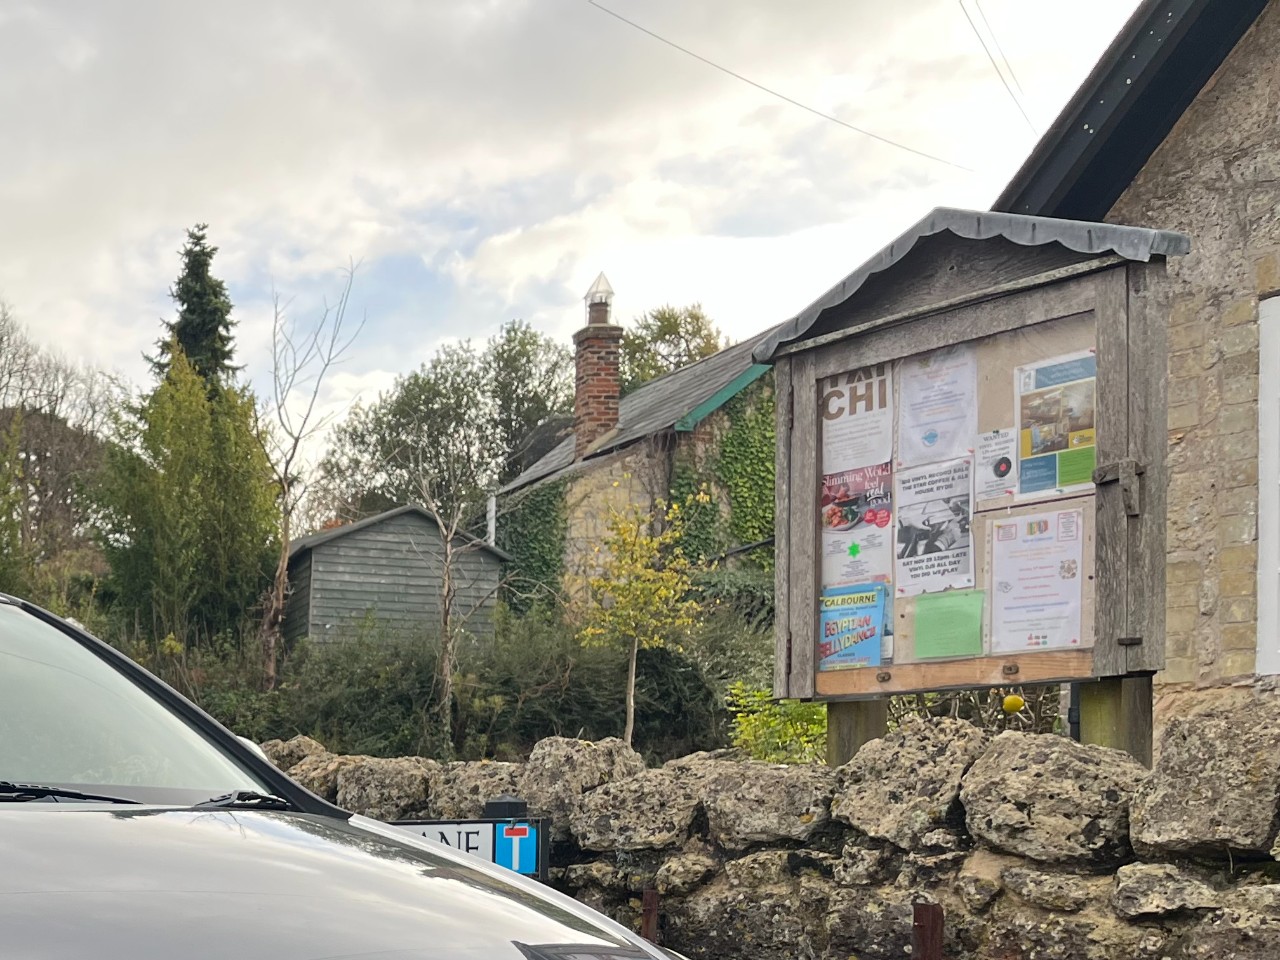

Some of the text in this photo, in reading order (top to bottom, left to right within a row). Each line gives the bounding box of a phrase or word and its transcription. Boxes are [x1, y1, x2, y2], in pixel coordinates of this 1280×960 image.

[823, 379, 887, 421] CHI
[983, 432, 1009, 442] WANTED
[864, 463, 891, 478] World
[912, 474, 927, 483] VINYL
[928, 469, 952, 478] RECORD
[953, 466, 969, 474] SALE
[864, 477, 879, 490] feel
[866, 482, 884, 498] real
[913, 481, 927, 489] STAR
[928, 477, 950, 486] COFFEE
[914, 487, 934, 495] HOUSE
[824, 594, 876, 608] CALBOURNE
[825, 615, 872, 638] EGYPTIAN
